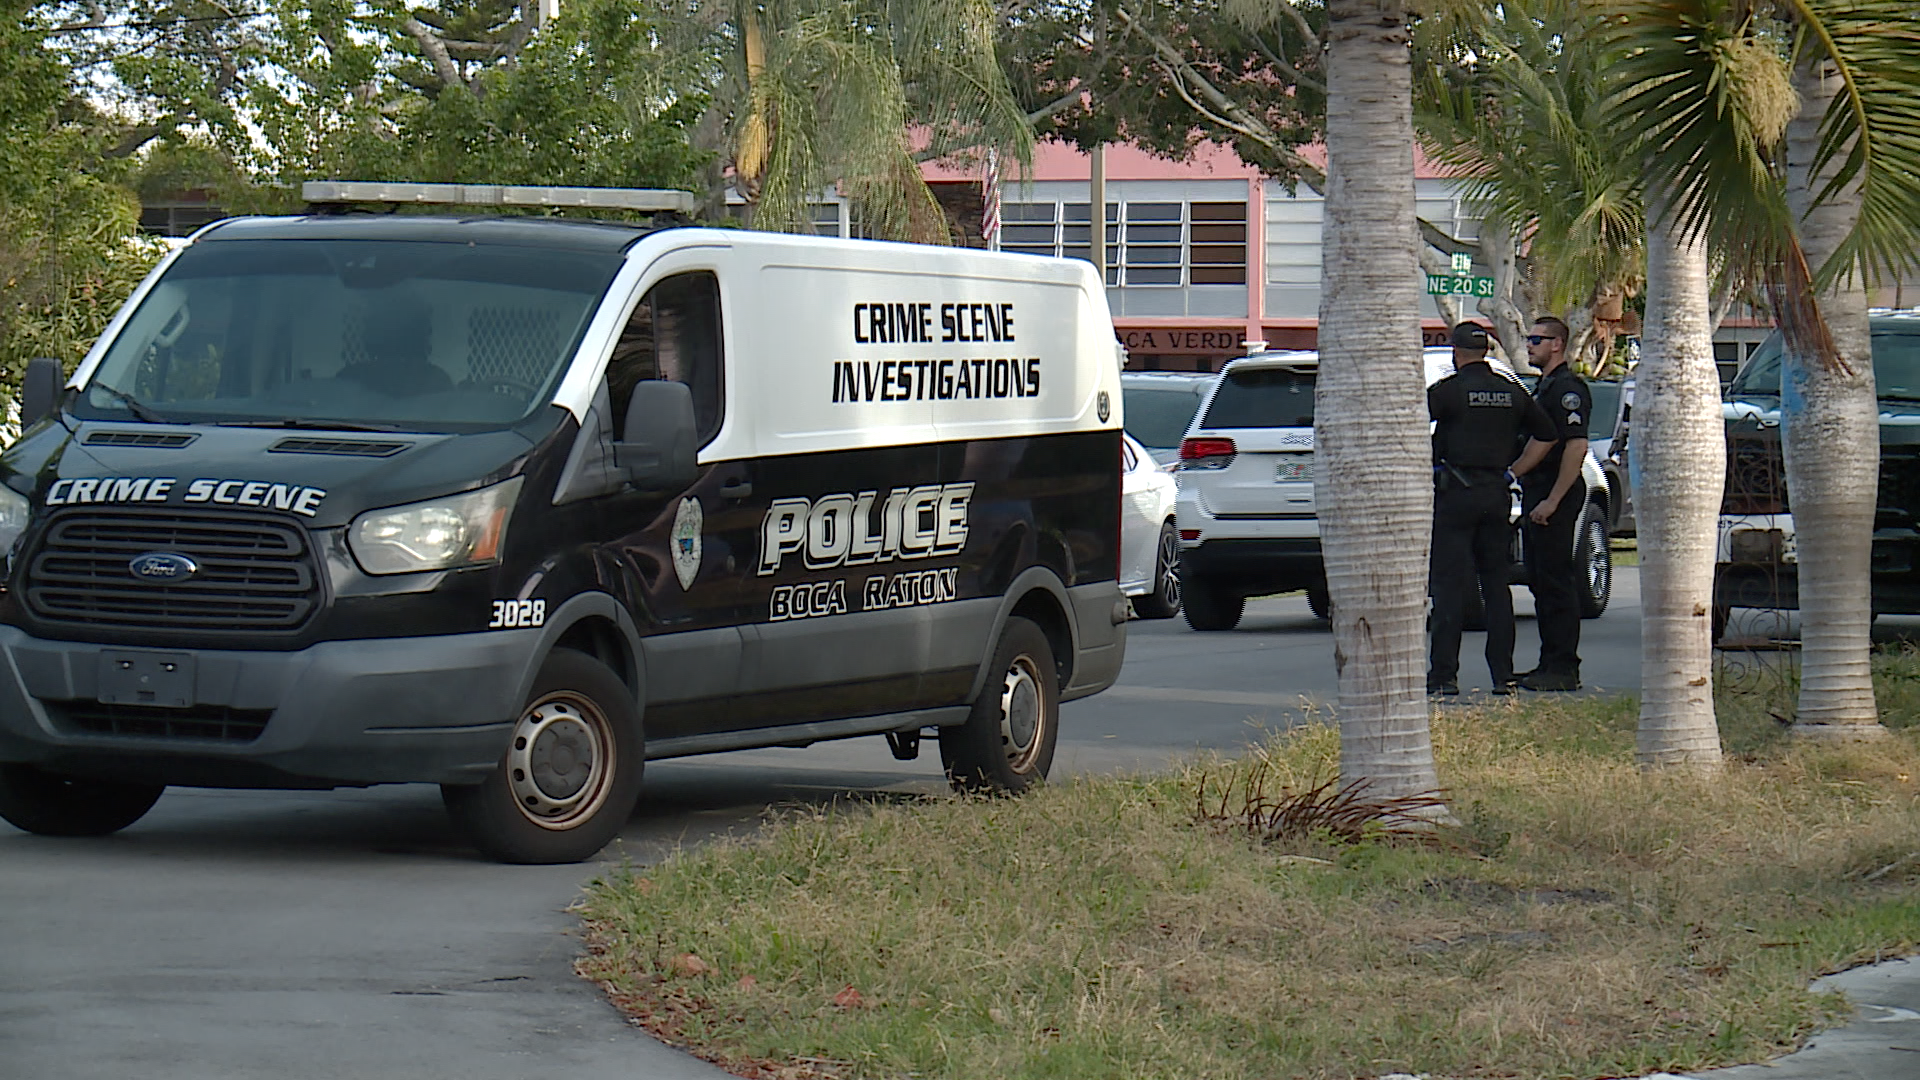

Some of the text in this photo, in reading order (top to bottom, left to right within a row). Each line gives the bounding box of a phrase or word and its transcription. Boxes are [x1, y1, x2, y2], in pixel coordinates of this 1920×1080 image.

[1429, 276, 1494, 296] NE 20 St
[854, 302, 1015, 344] CRIME SCENE
[1117, 331, 1248, 349] CA VERDE
[832, 358, 1040, 403] INVESTIGATIONS
[1468, 391, 1512, 403] POLICE
[45, 478, 326, 517] CRIME SCENE
[756, 481, 976, 577] POLICE
[141, 557, 177, 577] Ford
[769, 567, 959, 622] BOCA RATON
[489, 599, 546, 628] 3028
